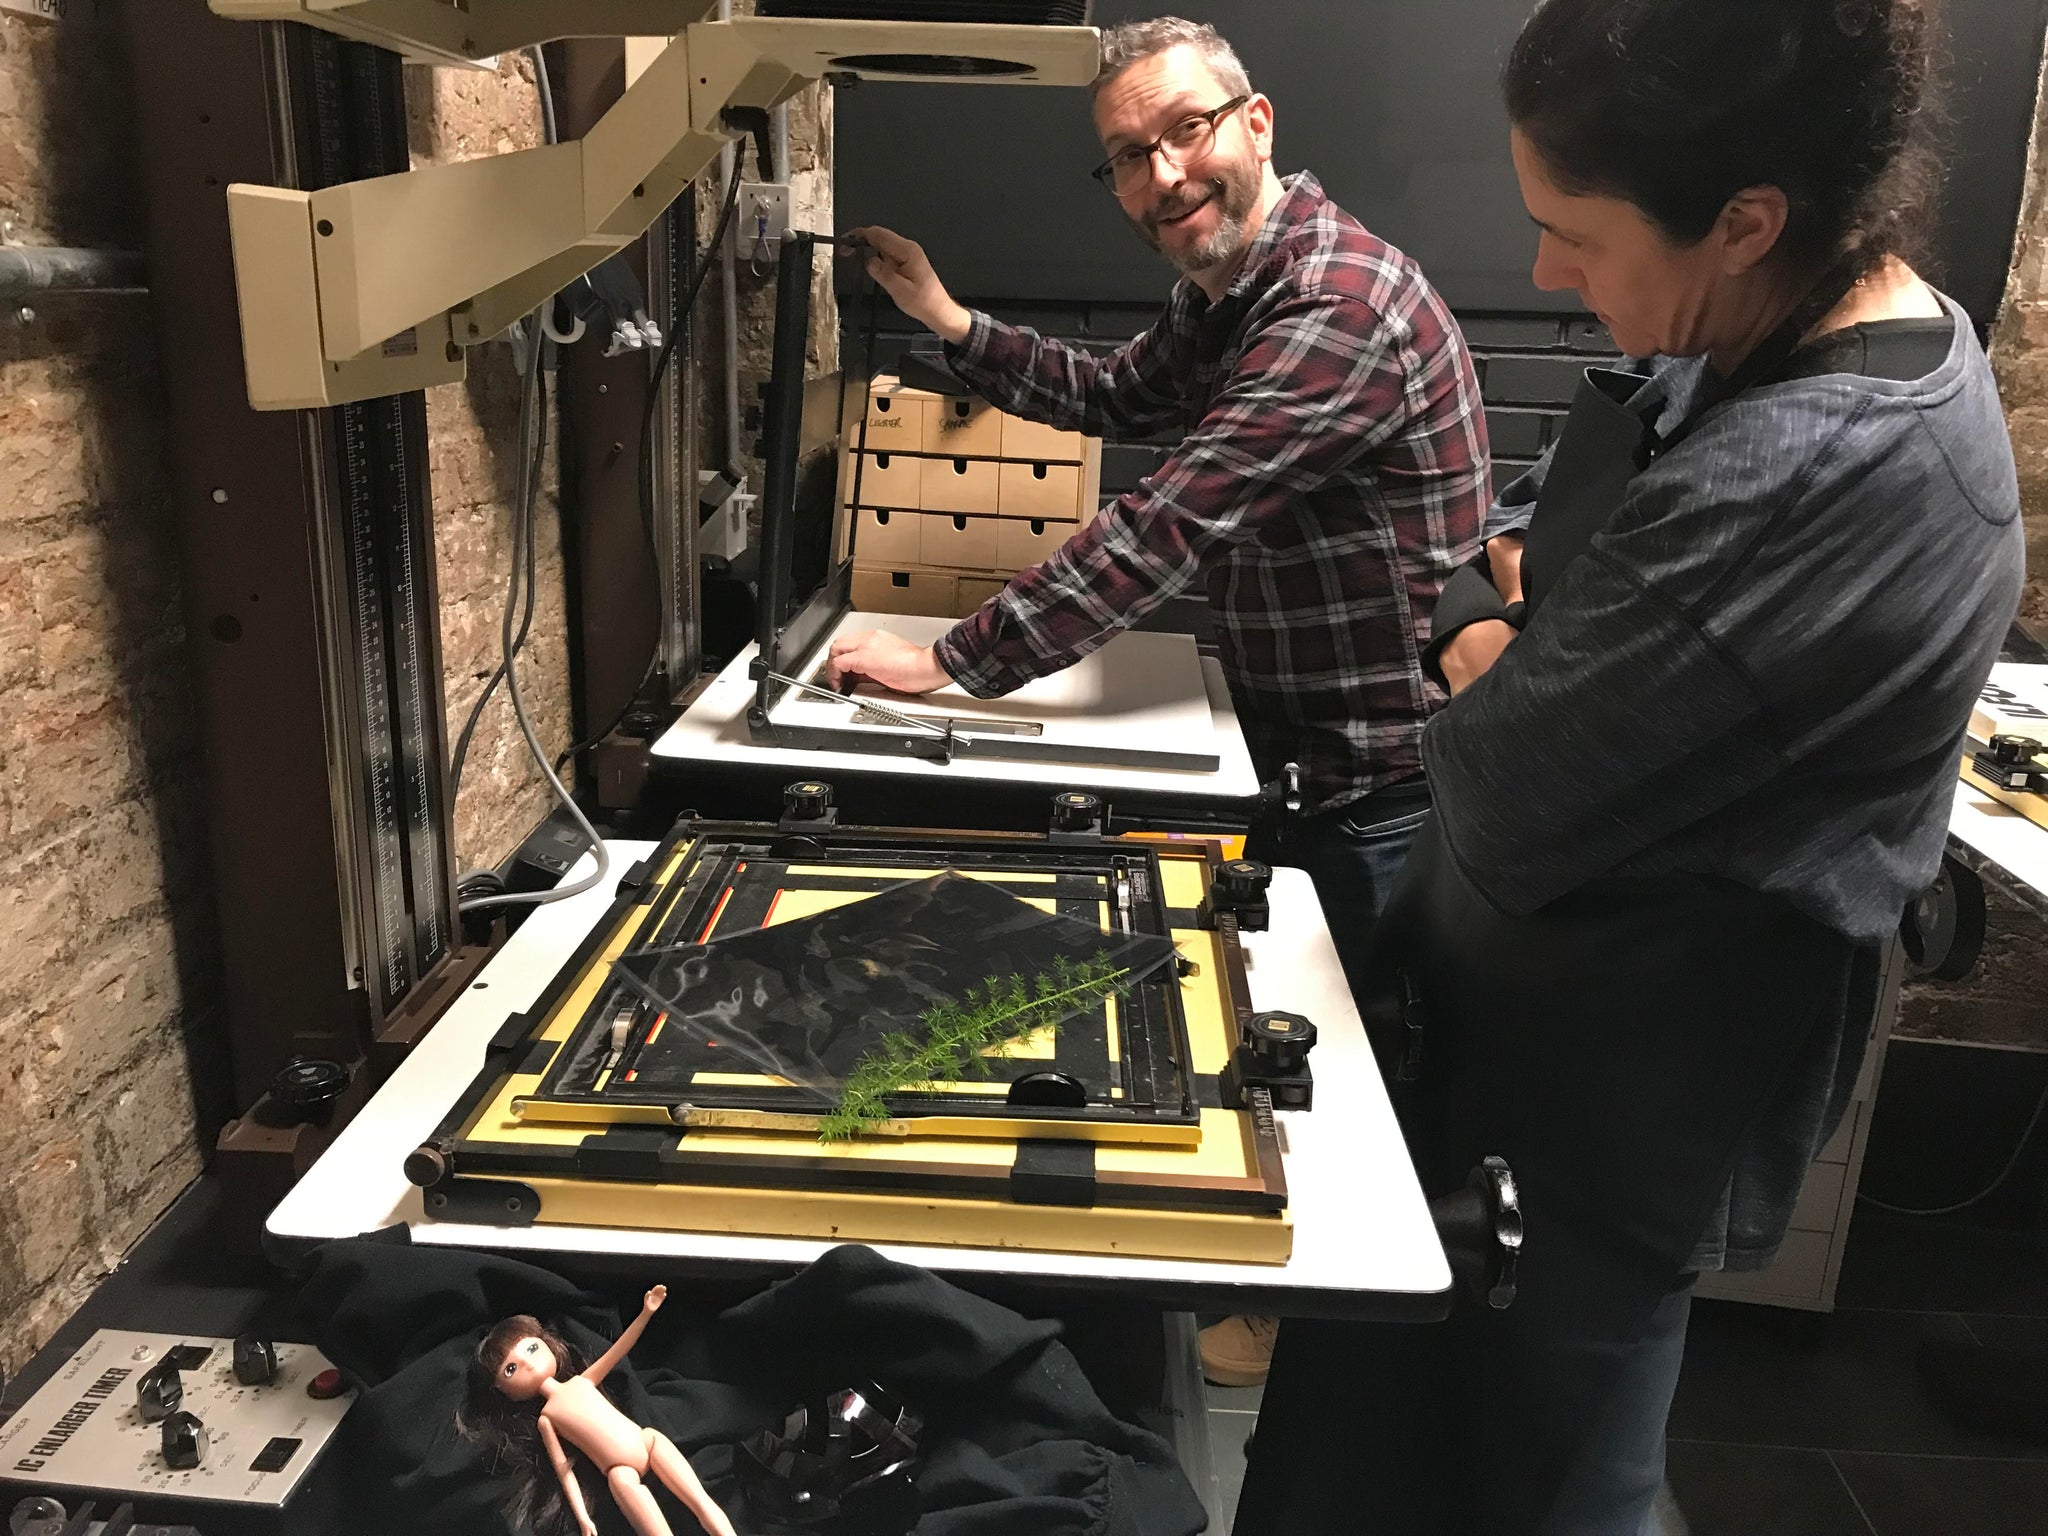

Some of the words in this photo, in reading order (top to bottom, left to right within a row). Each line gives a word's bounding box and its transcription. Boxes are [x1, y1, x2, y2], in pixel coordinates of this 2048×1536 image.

[82, 1366, 134, 1400] TIMER
[0, 1417, 30, 1451] LARGER
[28, 1400, 101, 1458] ENLARGER
[12, 1457, 45, 1473] IC
